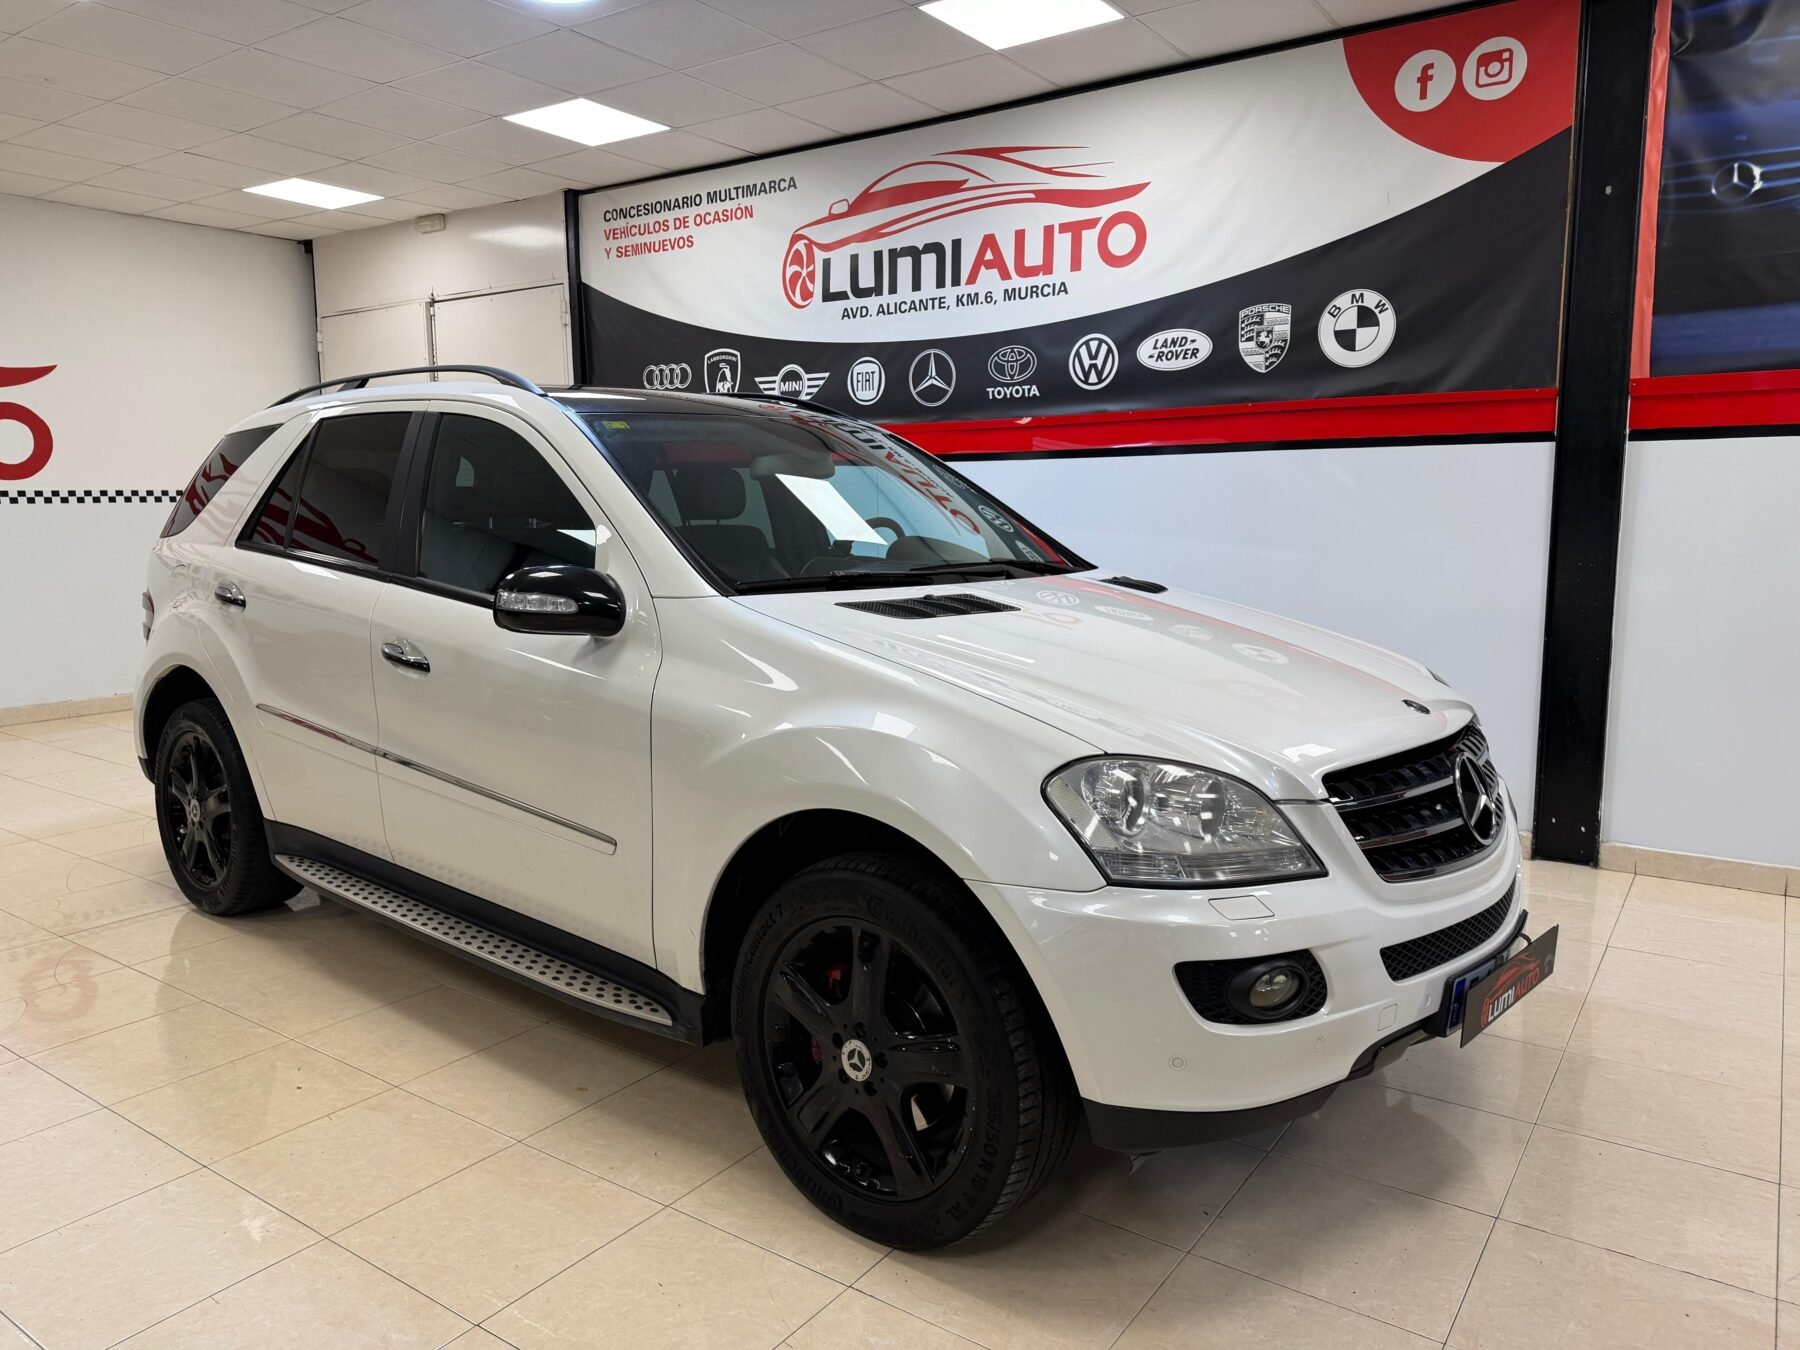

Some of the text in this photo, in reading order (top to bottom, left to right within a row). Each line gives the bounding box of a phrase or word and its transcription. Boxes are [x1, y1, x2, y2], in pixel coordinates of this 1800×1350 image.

[603, 176, 798, 222] CONCESIONARIO MULTIMARCA
[604, 203, 754, 241] VEHÍCULOS DE OCASIÓN
[604, 235, 694, 260] Y SEMINUEVOS
[841, 281, 1069, 320] AVD. ALICANTE, KM.6, MURCIA
[1241, 304, 1290, 319] PORSCHE
[707, 355, 737, 364] LAMBORGHINI
[780, 380, 803, 392] MINI
[856, 371, 876, 392] FIAT
[986, 385, 1040, 399] TOYOTA
